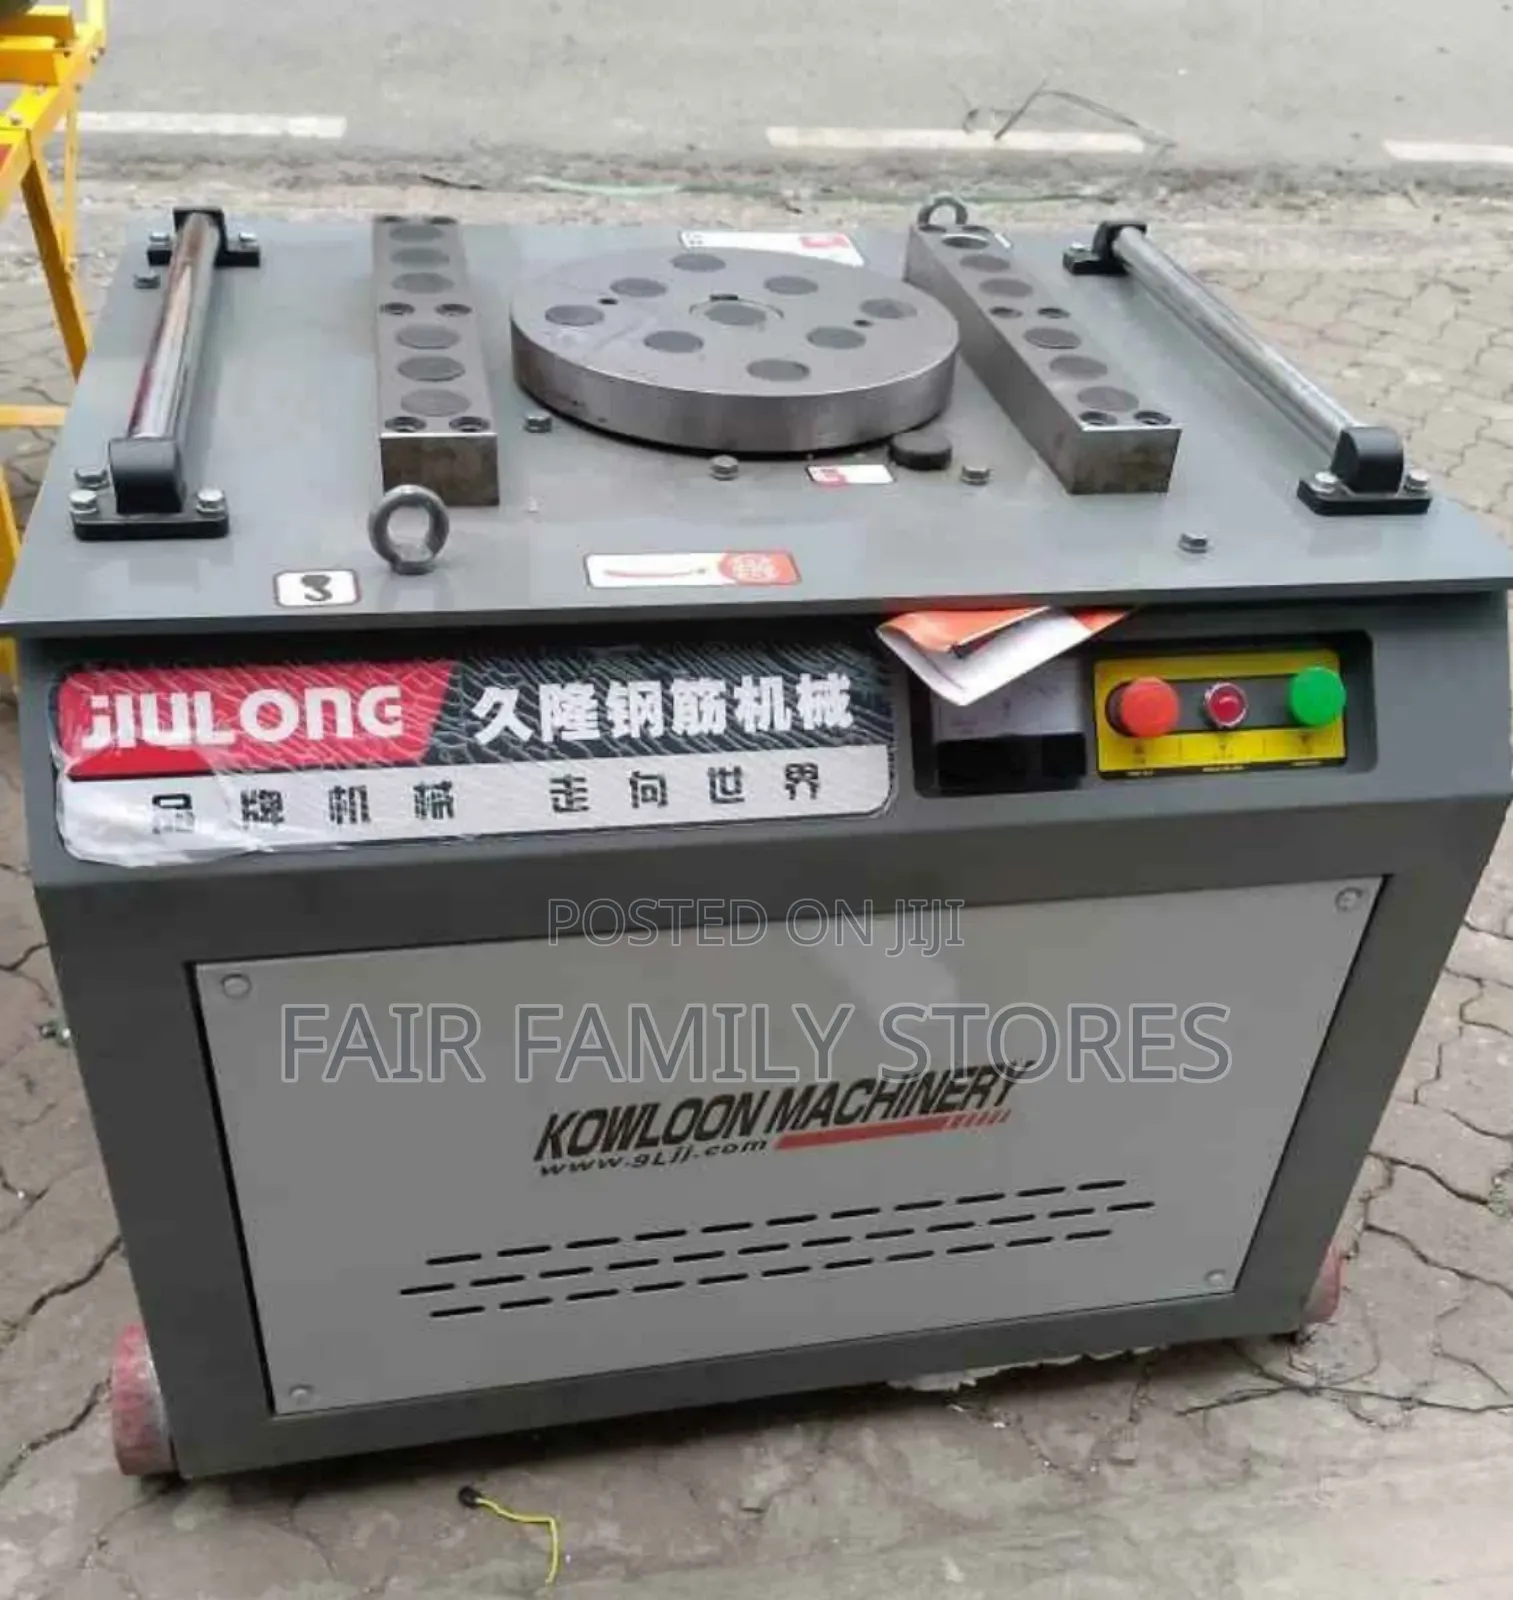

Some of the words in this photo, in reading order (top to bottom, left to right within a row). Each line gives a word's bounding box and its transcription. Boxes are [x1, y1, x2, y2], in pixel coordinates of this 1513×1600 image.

[472, 672, 853, 745] 久隆钢筋机械
[549, 762, 820, 814] 走向世界
[534, 1090, 770, 1162] KOWLOON
[763, 1059, 1036, 1134] MACHINERY
